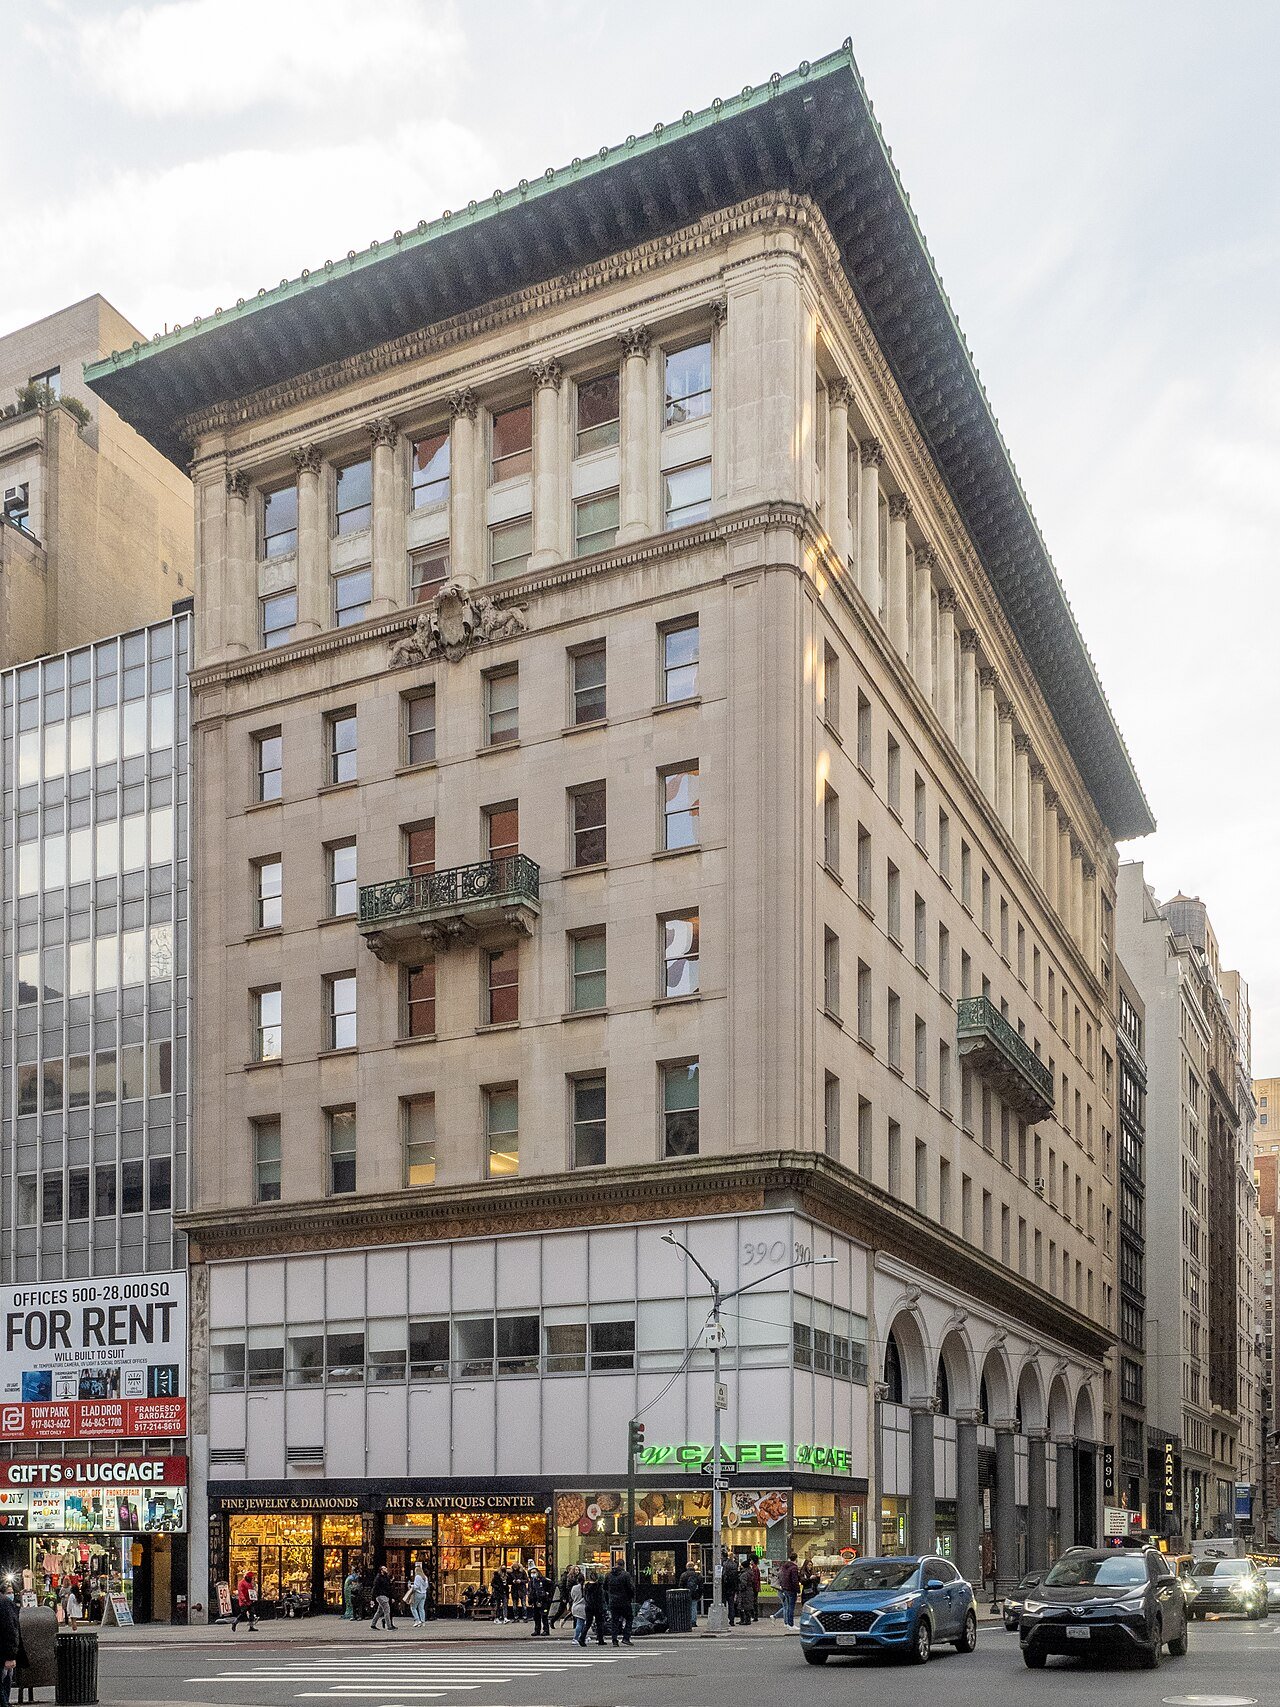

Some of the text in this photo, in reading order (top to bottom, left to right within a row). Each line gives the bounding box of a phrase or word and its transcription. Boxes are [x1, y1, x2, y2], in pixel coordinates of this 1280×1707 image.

[743, 1241, 785, 1265] 390
[794, 1242, 811, 1267] 390
[13, 1282, 170, 1307] OFFICES 500-28,000 SQ
[6, 1301, 178, 1351] FOR RENT
[54, 1349, 126, 1362] WILL BUILT TO SUIT
[31, 1406, 70, 1418] TONY PARK
[81, 1404, 122, 1417] ELAD DROR
[134, 1404, 181, 1413] FRANCESCO
[138, 1412, 177, 1420] BARDAZZI
[676, 1444, 784, 1462] CAFE
[813, 1446, 852, 1467] CAFE
[1165, 1444, 1173, 1486] PARK
[8, 1462, 164, 1483] GIFTS & LUGGAGE
[8, 1493, 24, 1504] NY
[221, 1497, 359, 1511] FINE JEWELRY & DIAMONDS
[385, 1496, 535, 1509] ARTS & ANTIQUES CENTER
[8, 1515, 24, 1527] NY
